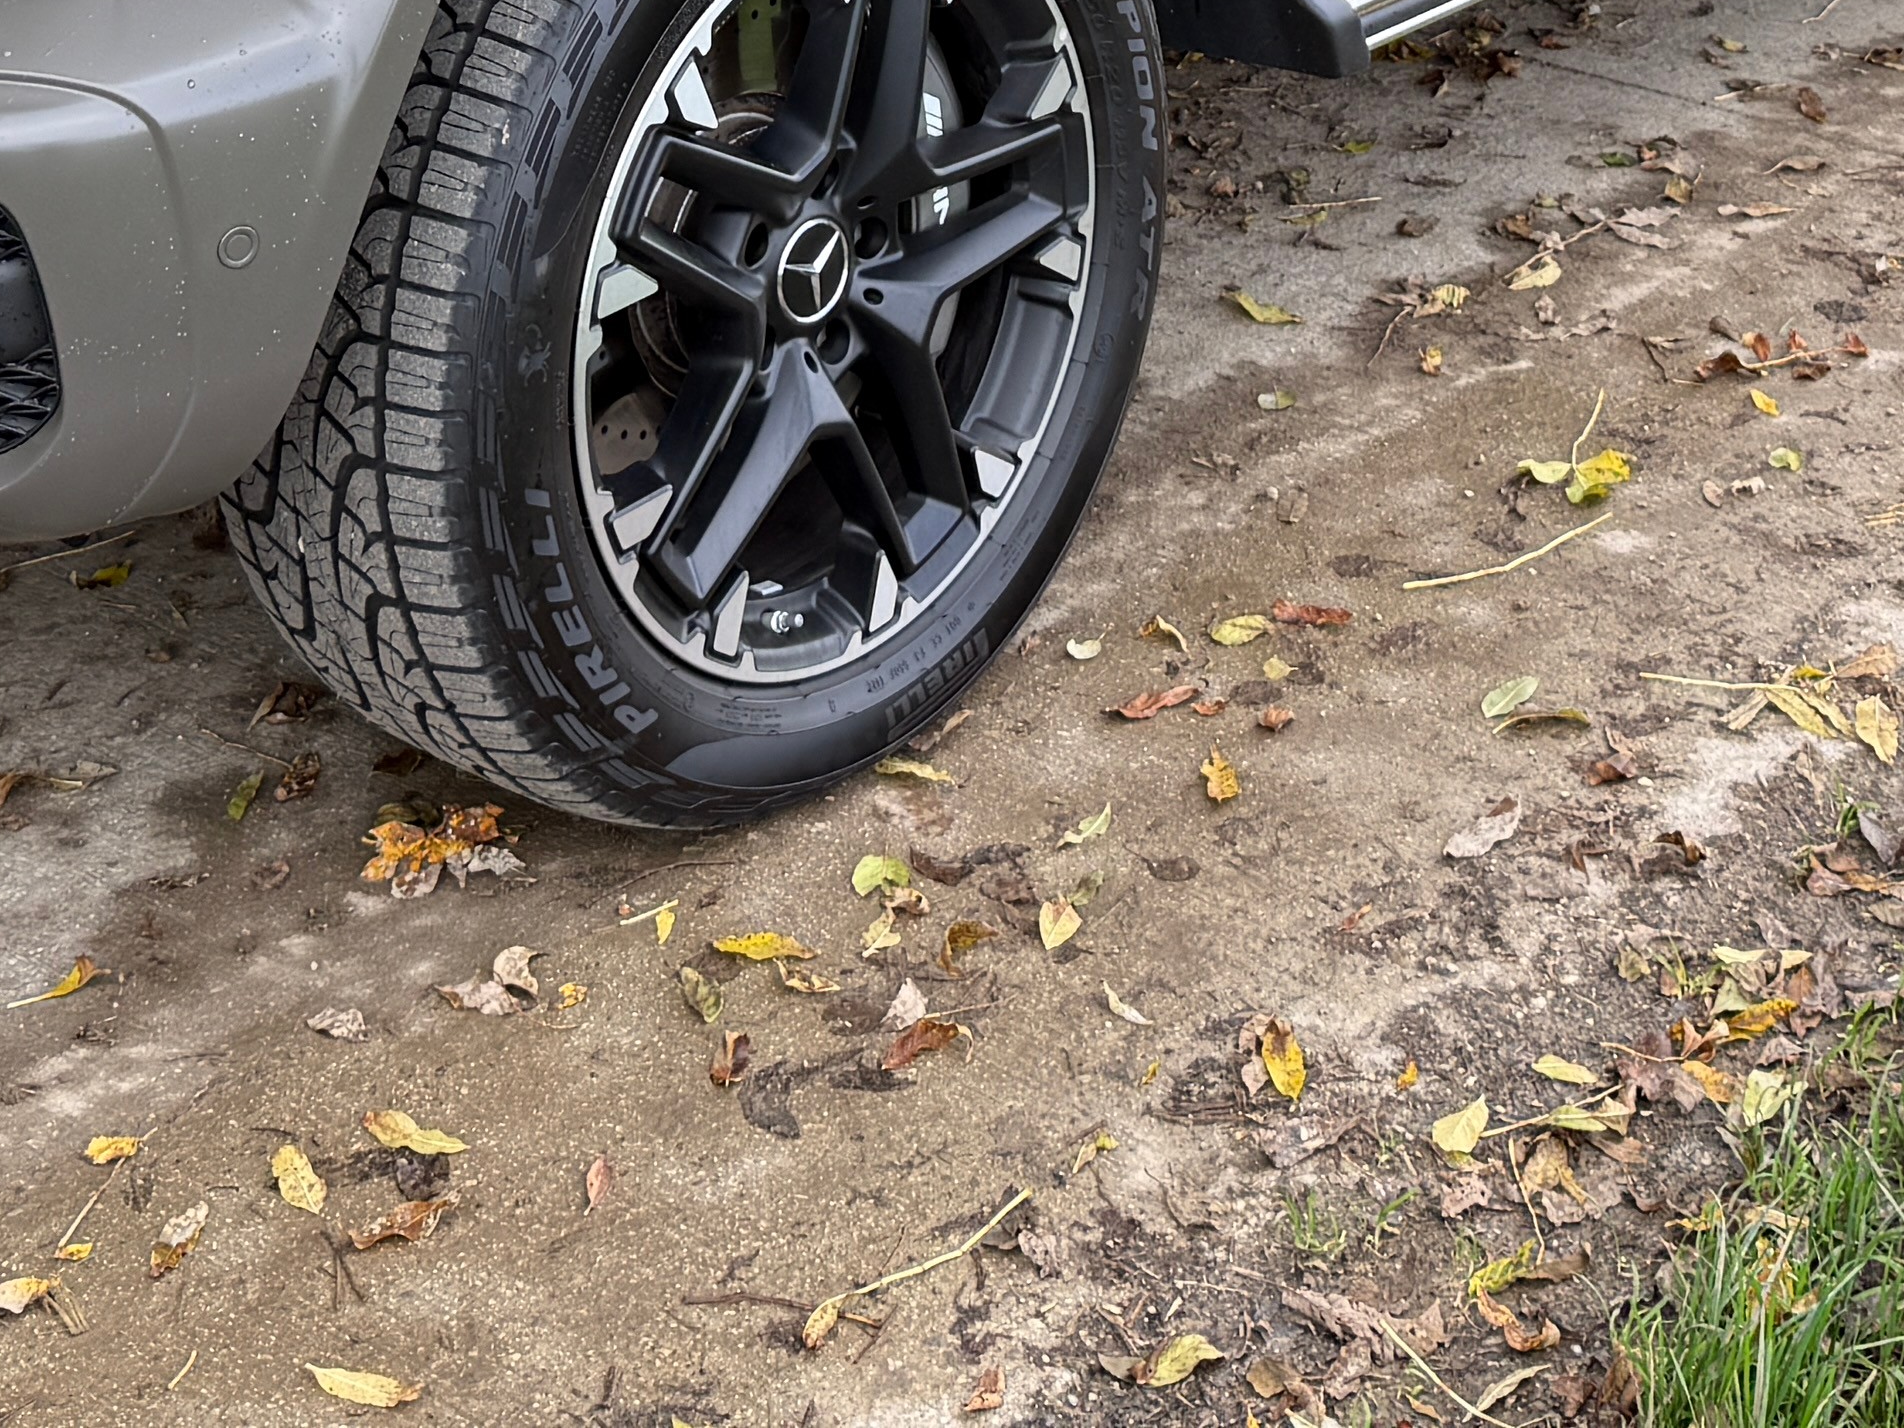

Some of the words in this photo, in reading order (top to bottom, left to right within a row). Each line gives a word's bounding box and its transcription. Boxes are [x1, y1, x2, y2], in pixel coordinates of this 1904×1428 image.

[1130, 175, 1157, 321] ATR
[524, 488, 658, 734] PIRELLI
[886, 627, 990, 743] PIRELLI
